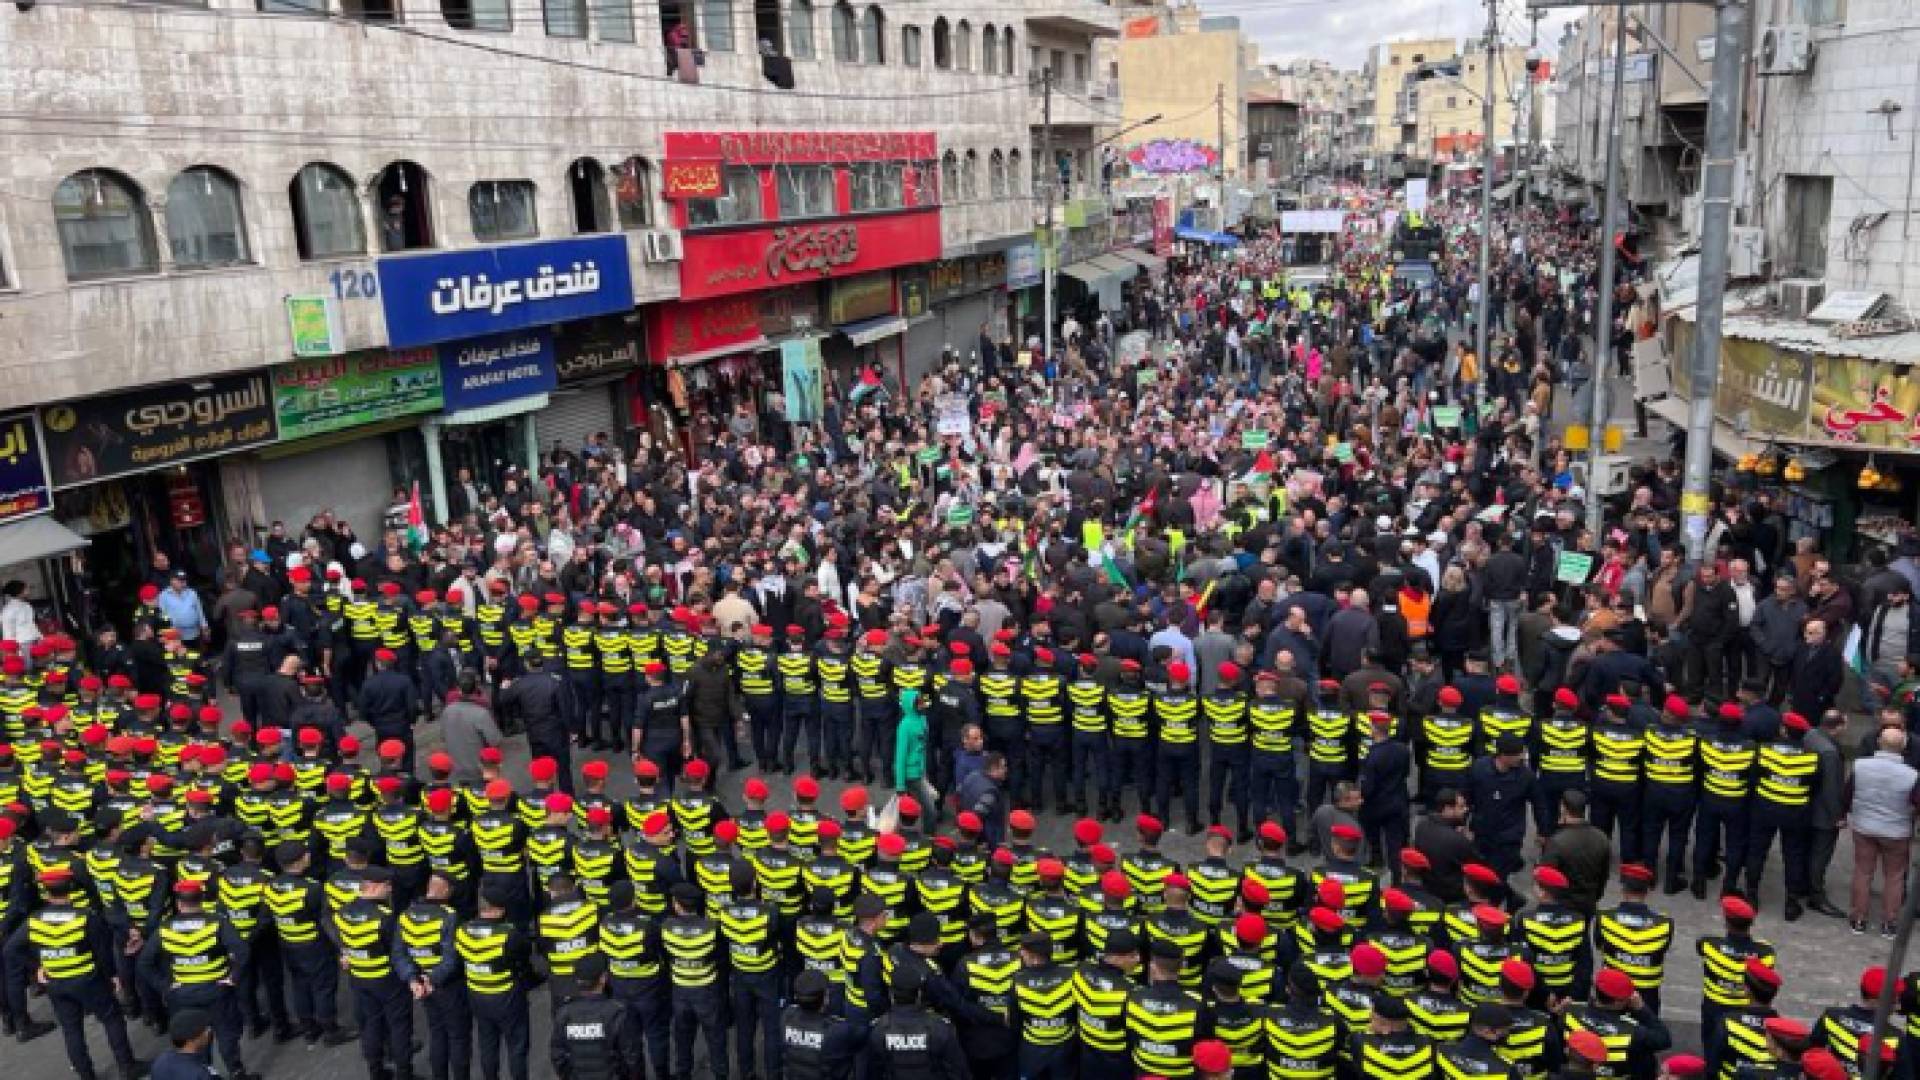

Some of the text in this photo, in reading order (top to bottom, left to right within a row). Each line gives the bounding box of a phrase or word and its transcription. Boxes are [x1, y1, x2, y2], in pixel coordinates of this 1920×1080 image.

[330, 269, 377, 300] 120
[431, 262, 601, 315] فندق عرفات
[458, 347, 501, 367] عرفات
[502, 337, 541, 358] فندق
[126, 377, 266, 436] السروجي
[565, 1022, 605, 1040] POLICE
[785, 1025, 824, 1049] POLICE
[884, 1033, 927, 1051] POLICE
